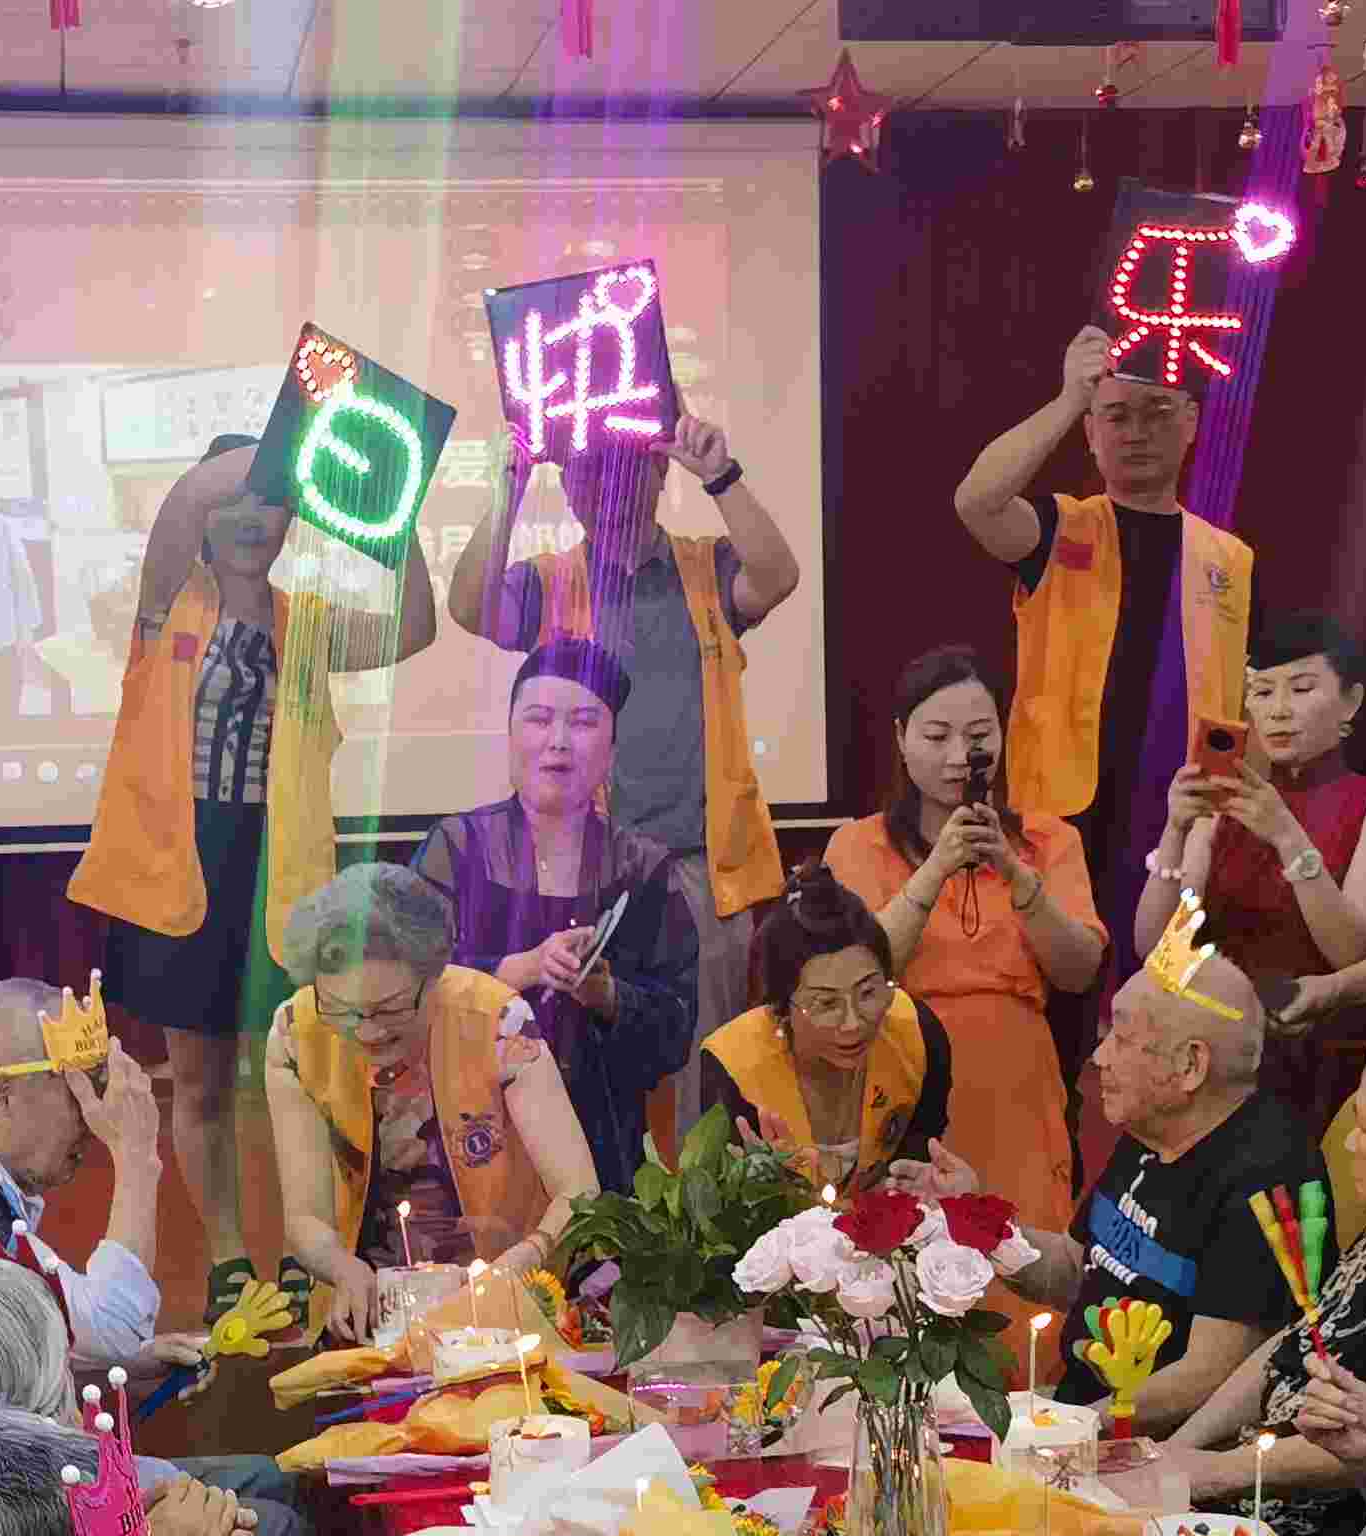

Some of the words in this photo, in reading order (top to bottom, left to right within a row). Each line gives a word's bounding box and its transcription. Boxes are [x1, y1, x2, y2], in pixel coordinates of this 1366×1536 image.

[504, 294, 663, 455] 快
[1110, 224, 1243, 386] 乐
[294, 391, 424, 541] 日
